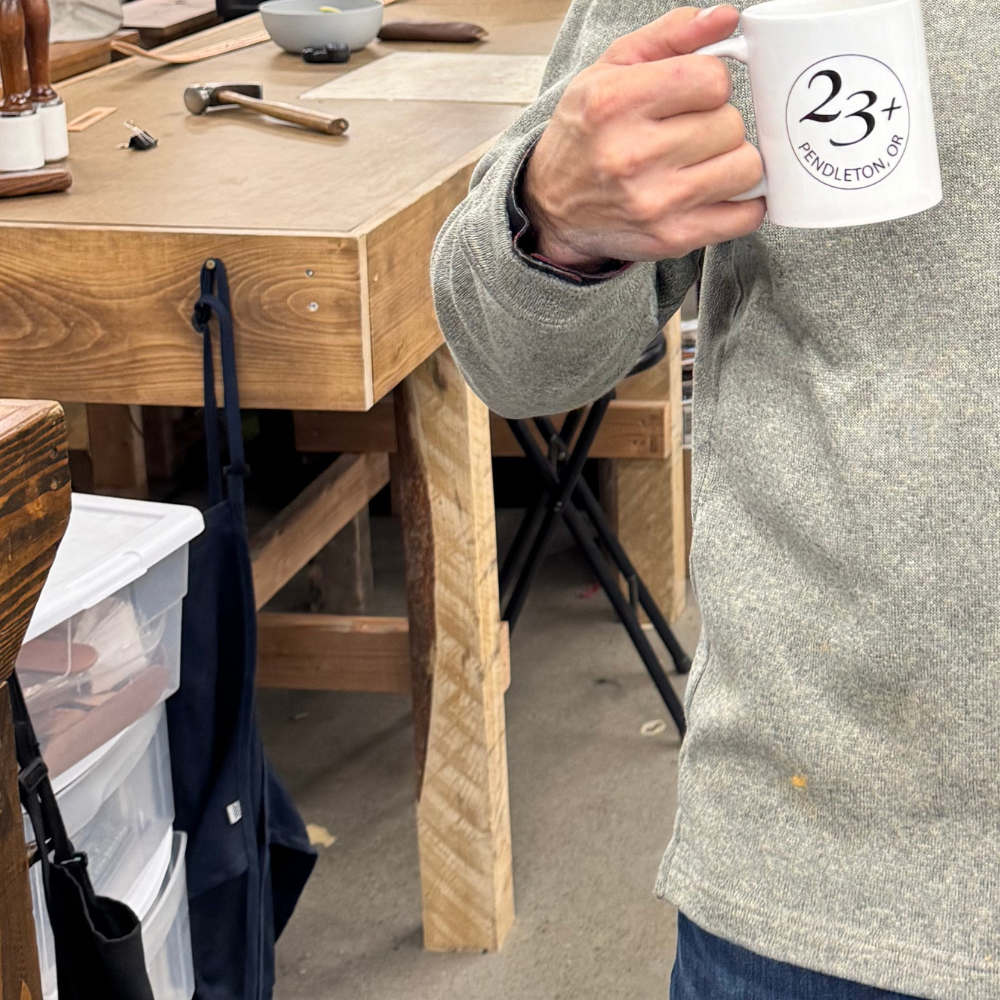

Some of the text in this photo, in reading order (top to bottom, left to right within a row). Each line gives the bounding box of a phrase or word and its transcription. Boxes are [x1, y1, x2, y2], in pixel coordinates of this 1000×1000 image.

[799, 69, 902, 147] 23+
[798, 134, 904, 182] PENDLETON, OR
